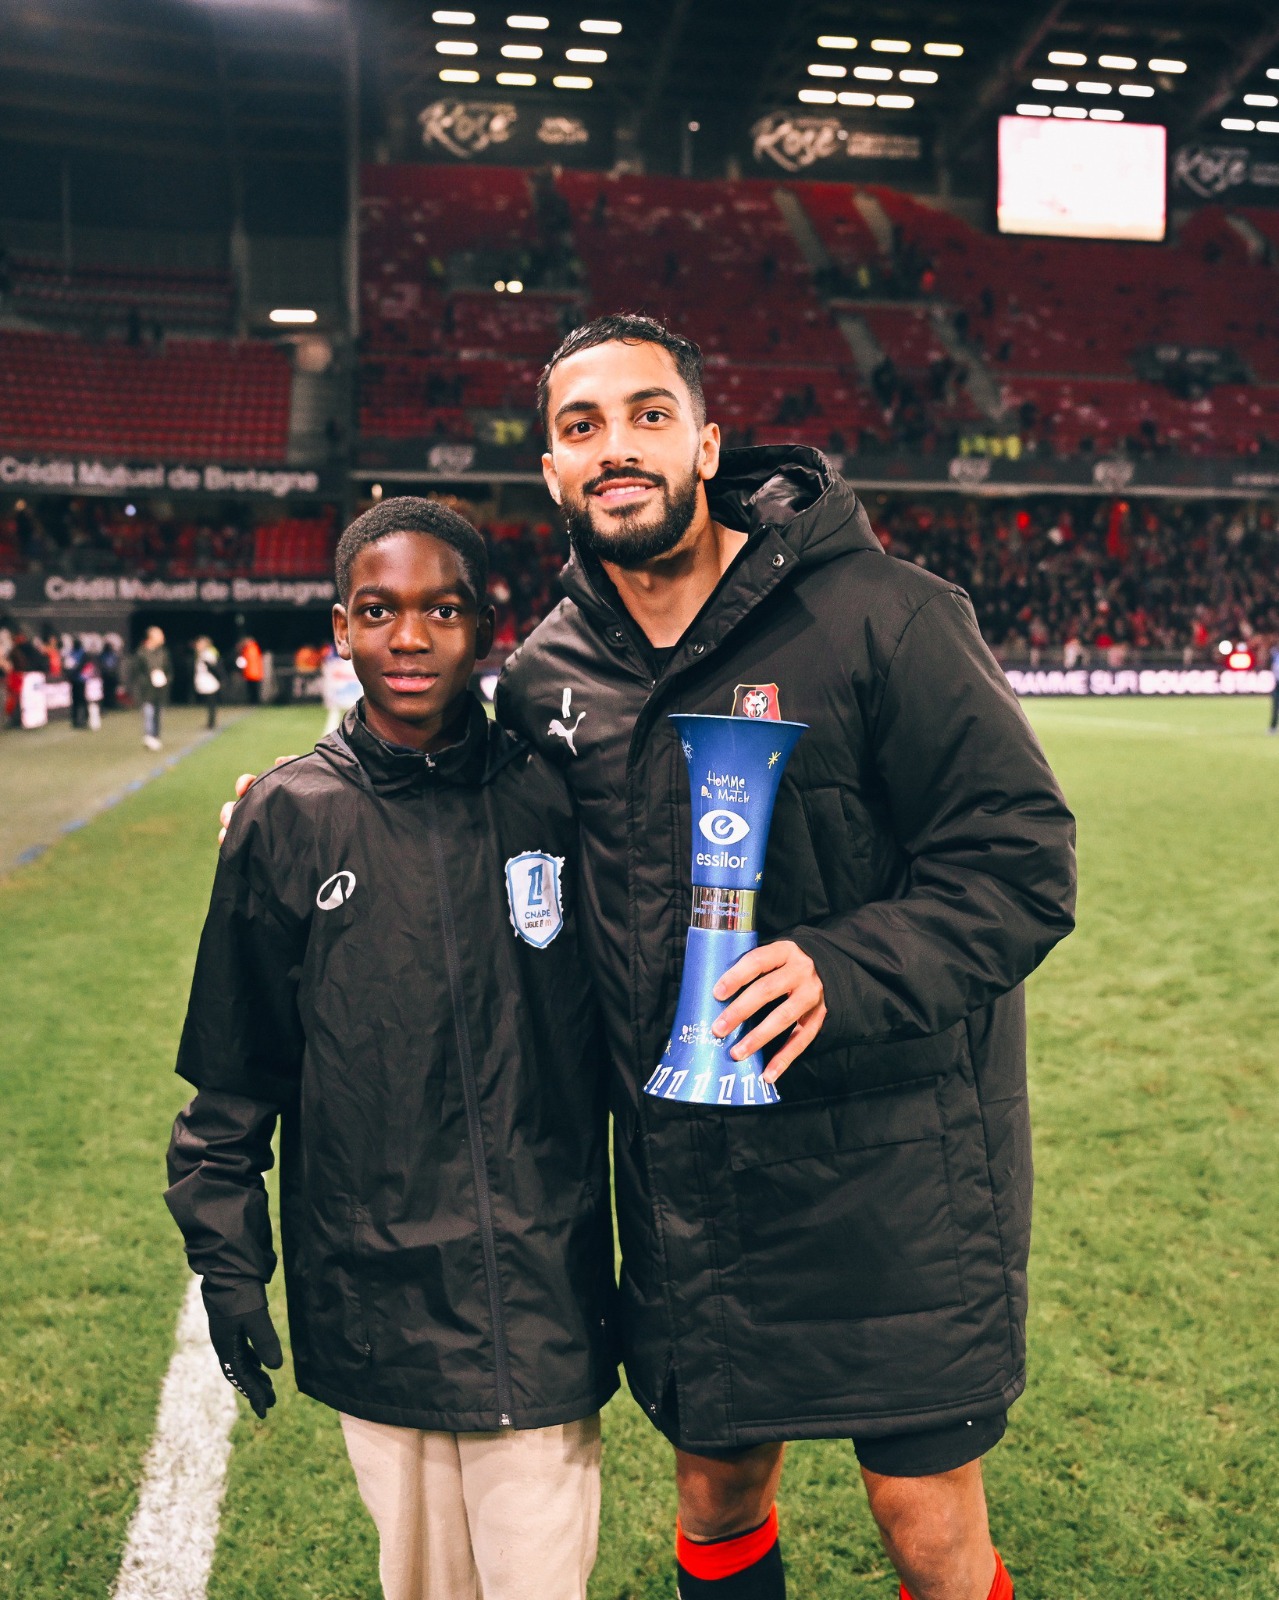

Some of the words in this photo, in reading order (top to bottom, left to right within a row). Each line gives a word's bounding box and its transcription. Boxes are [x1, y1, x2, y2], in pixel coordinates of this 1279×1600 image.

[79, 461, 164, 488] Mutuel
[168, 466, 200, 490] de
[204, 466, 318, 496] Bretagne
[119, 578, 197, 600] Mutuel
[200, 580, 229, 601] de
[232, 578, 335, 606] Bretagne
[696, 852, 748, 869] essilor
